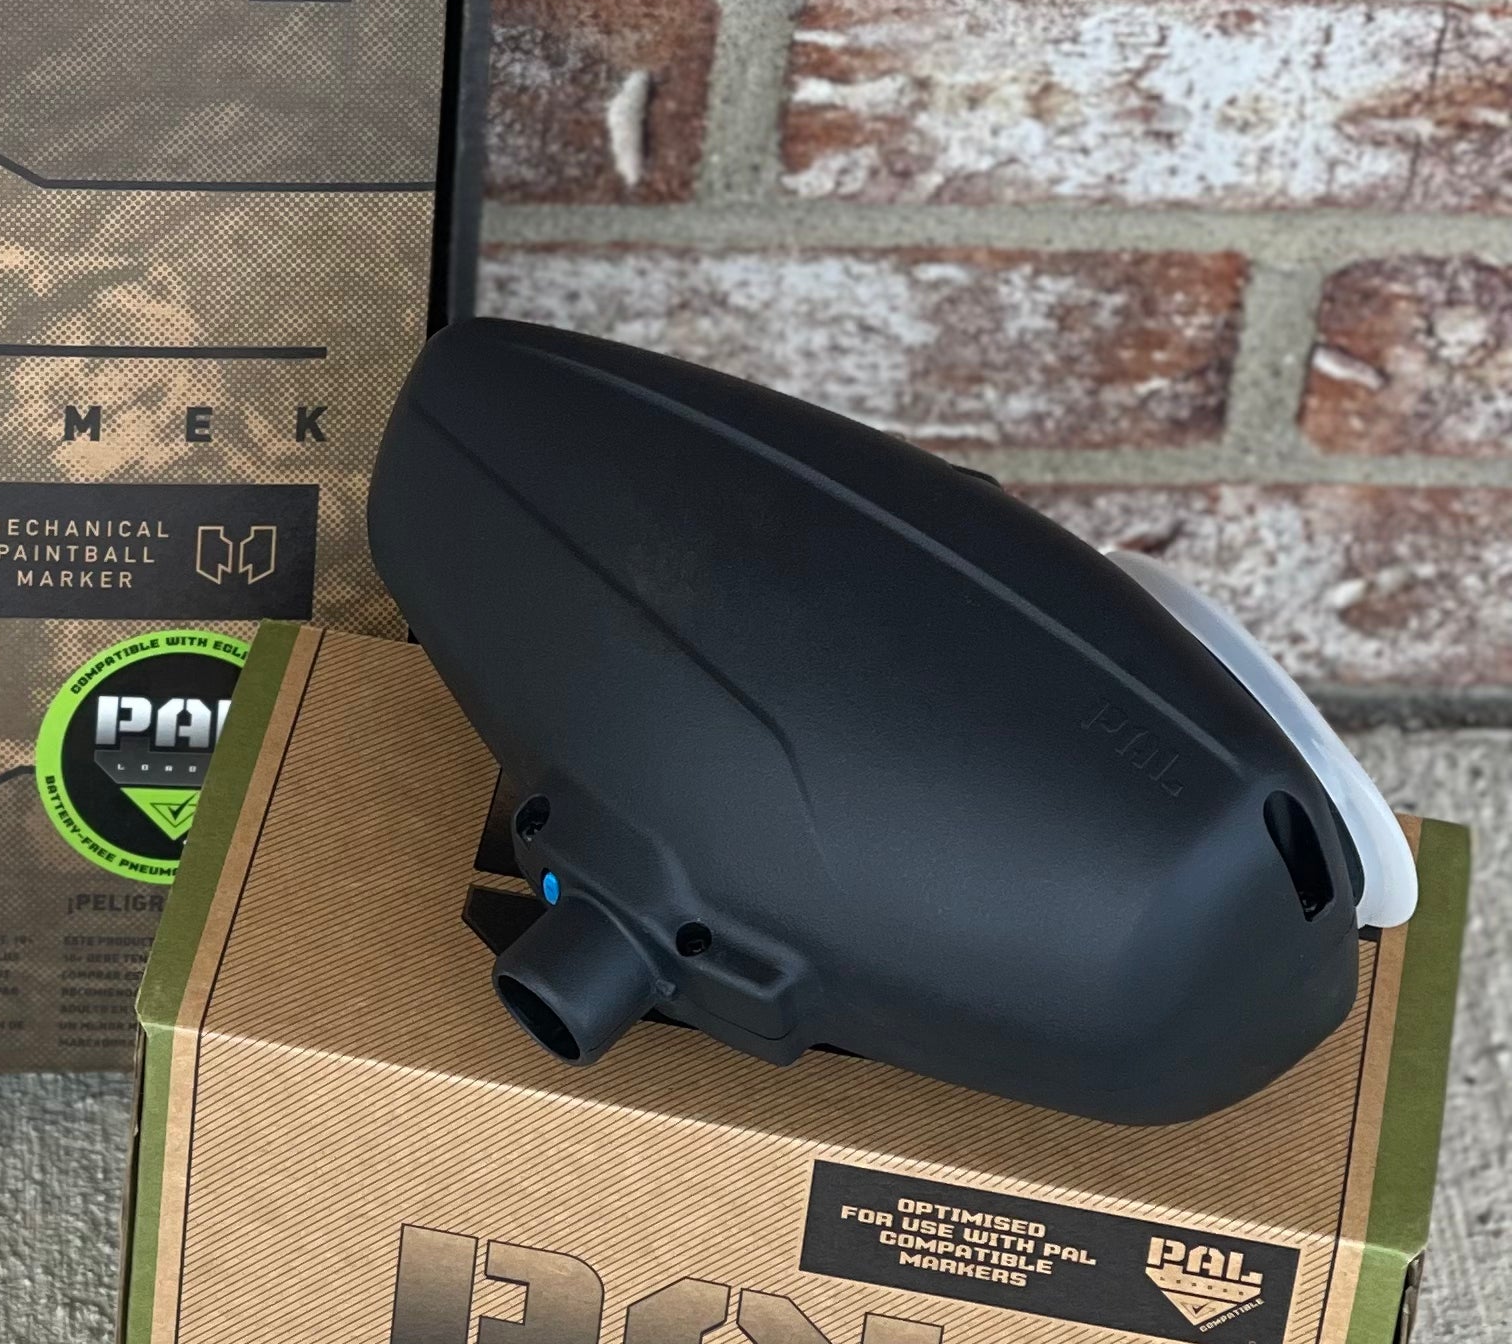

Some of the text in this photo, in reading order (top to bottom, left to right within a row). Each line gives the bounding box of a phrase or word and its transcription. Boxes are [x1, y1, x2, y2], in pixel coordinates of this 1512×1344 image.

[17, 570, 133, 588] MARKER
[70, 638, 159, 694] COMPATIBLE
[166, 636, 208, 647] WITH
[45, 775, 117, 862] BATTERY-FREE
[840, 1205, 1097, 1266] FOR USE WITH PAL
[897, 1198, 1047, 1239] OPTIMISED
[879, 1230, 1054, 1275] COMPATIBLE
[899, 1251, 1028, 1287] MARKERS
[1146, 1236, 1264, 1285] PAL
[1199, 1297, 1265, 1333] COMPATIBLE
